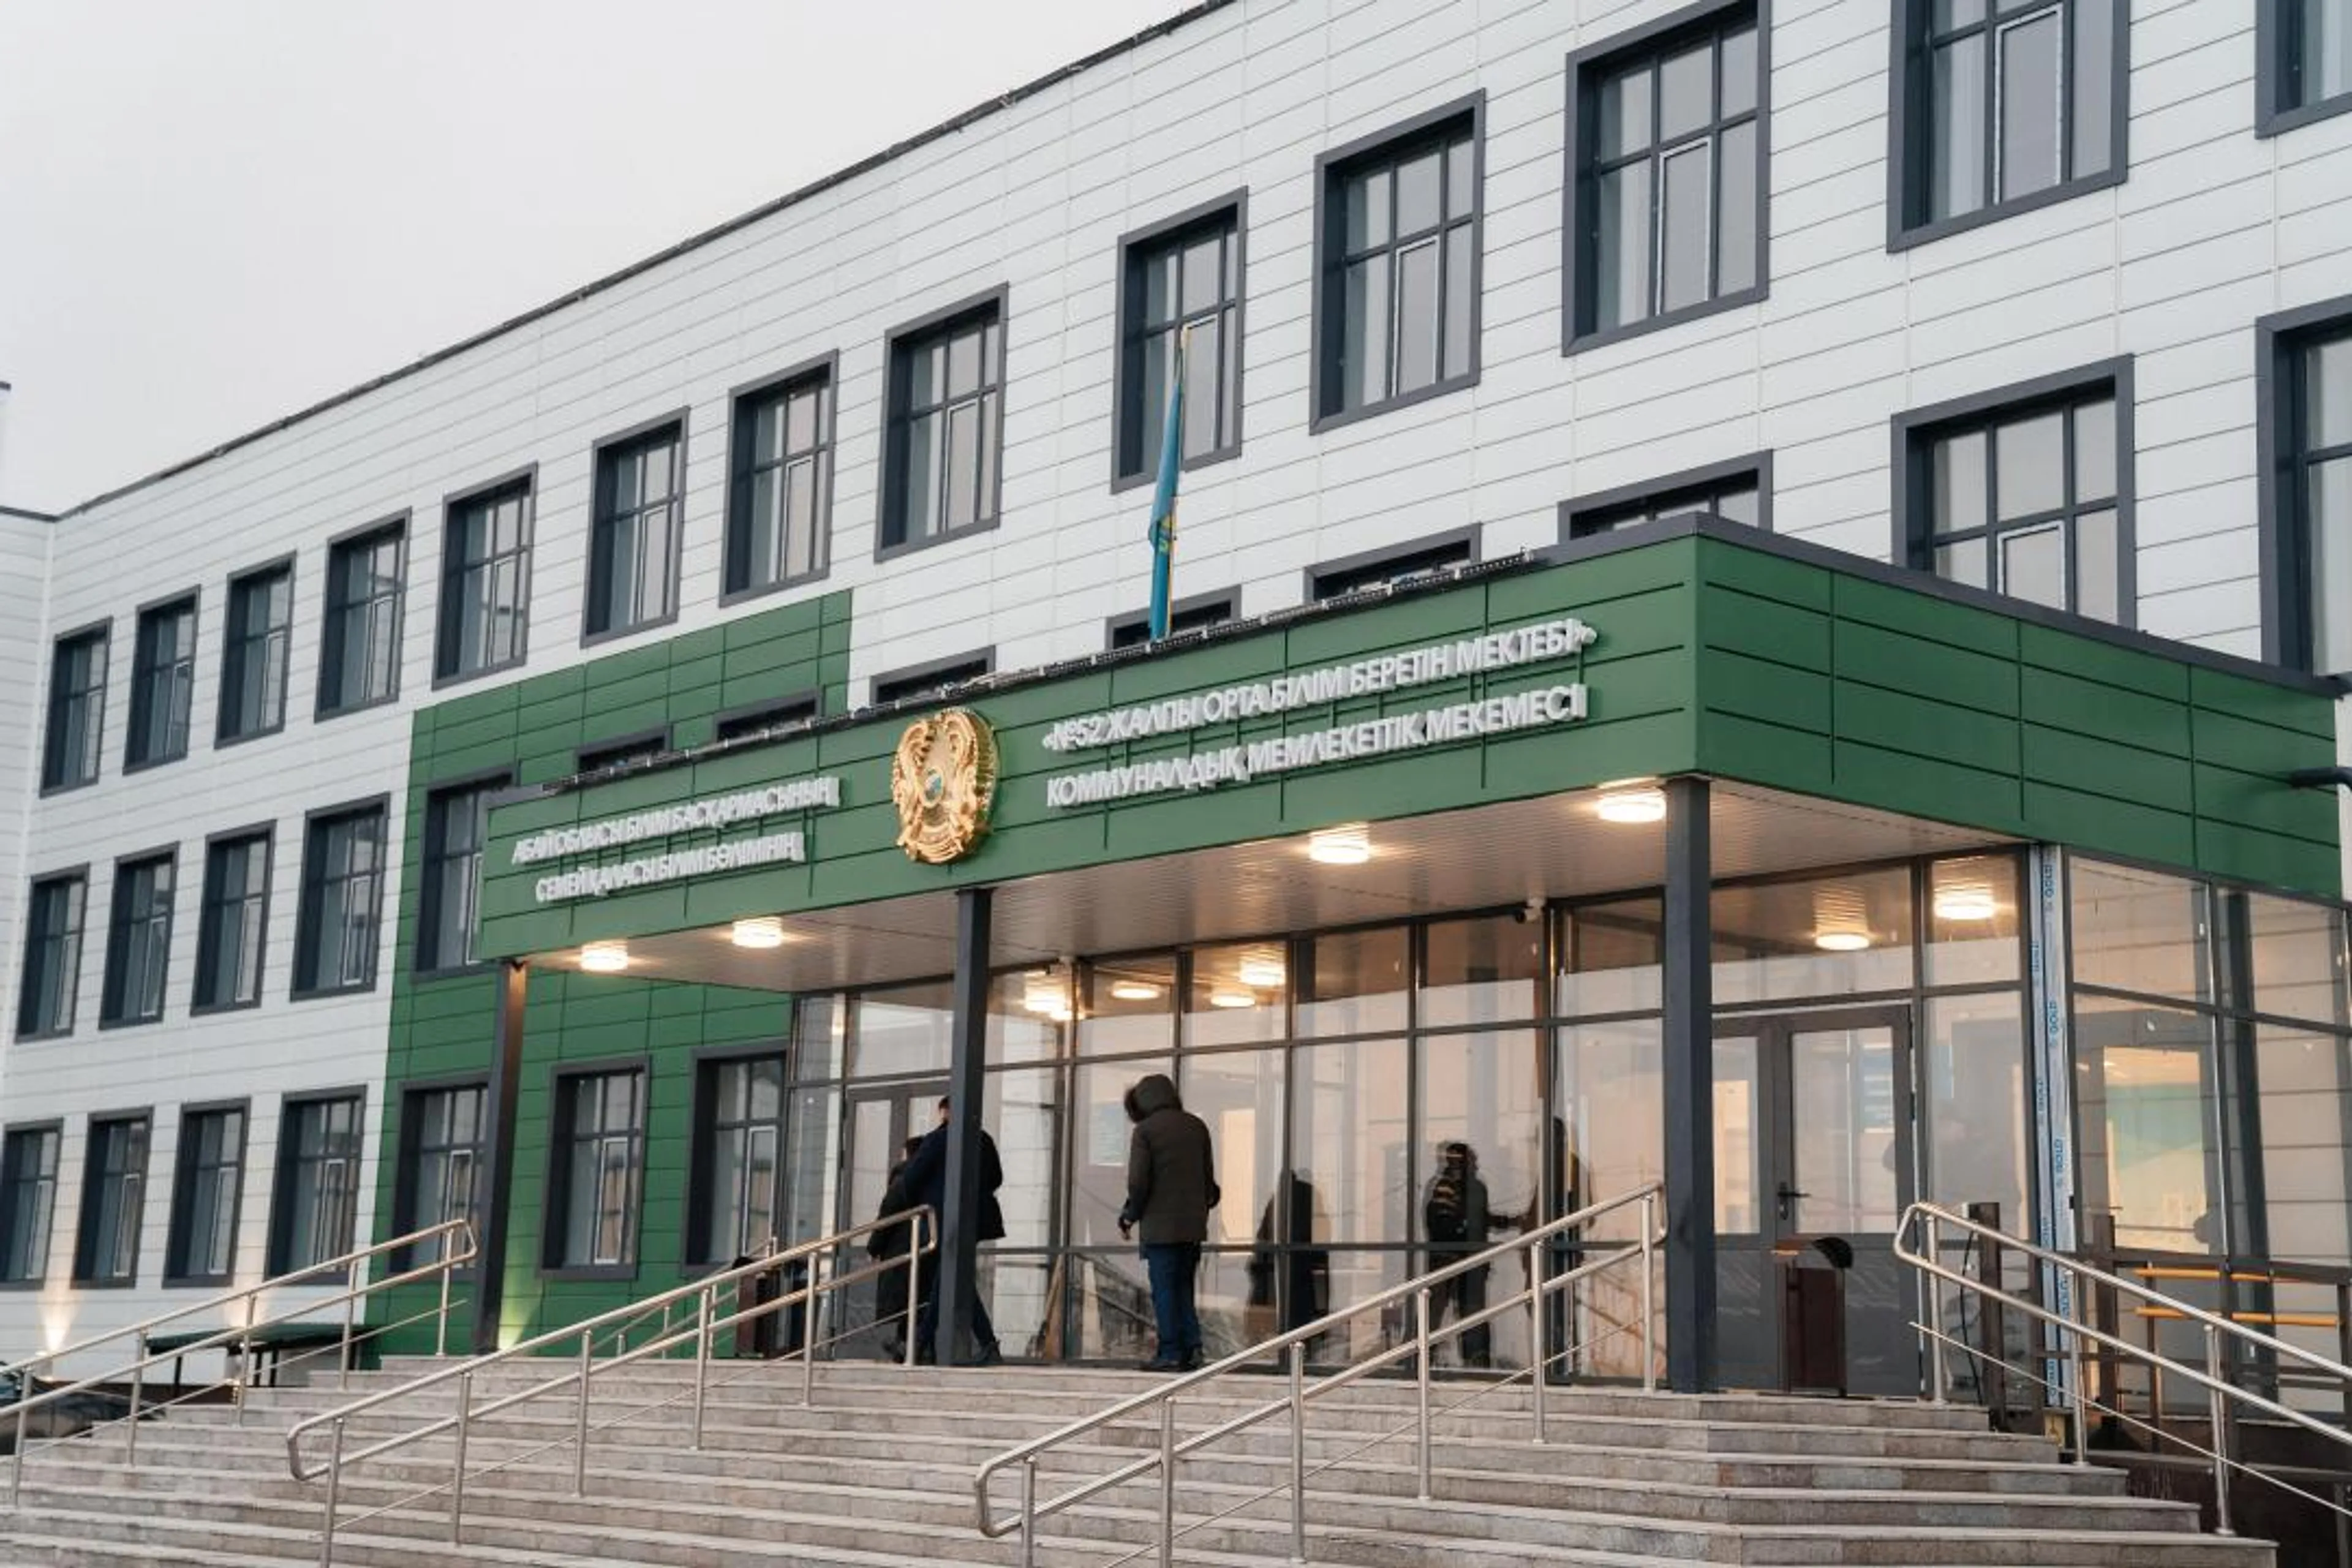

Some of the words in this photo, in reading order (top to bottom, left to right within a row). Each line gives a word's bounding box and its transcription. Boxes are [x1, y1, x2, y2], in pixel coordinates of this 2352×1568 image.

[1046, 745, 1247, 809] КОММУНАЛДЫҚ
[1248, 711, 1426, 774] МЕМЛЕКЕТІК
[1427, 682, 1586, 742] МЕКЕМЕСІ
[1107, 694, 1204, 744] ЖАЛПЫ
[1204, 680, 1271, 725] ОРТА
[1272, 664, 1349, 713] БІЛІМ
[1351, 642, 1456, 696] БЕРЕТІН
